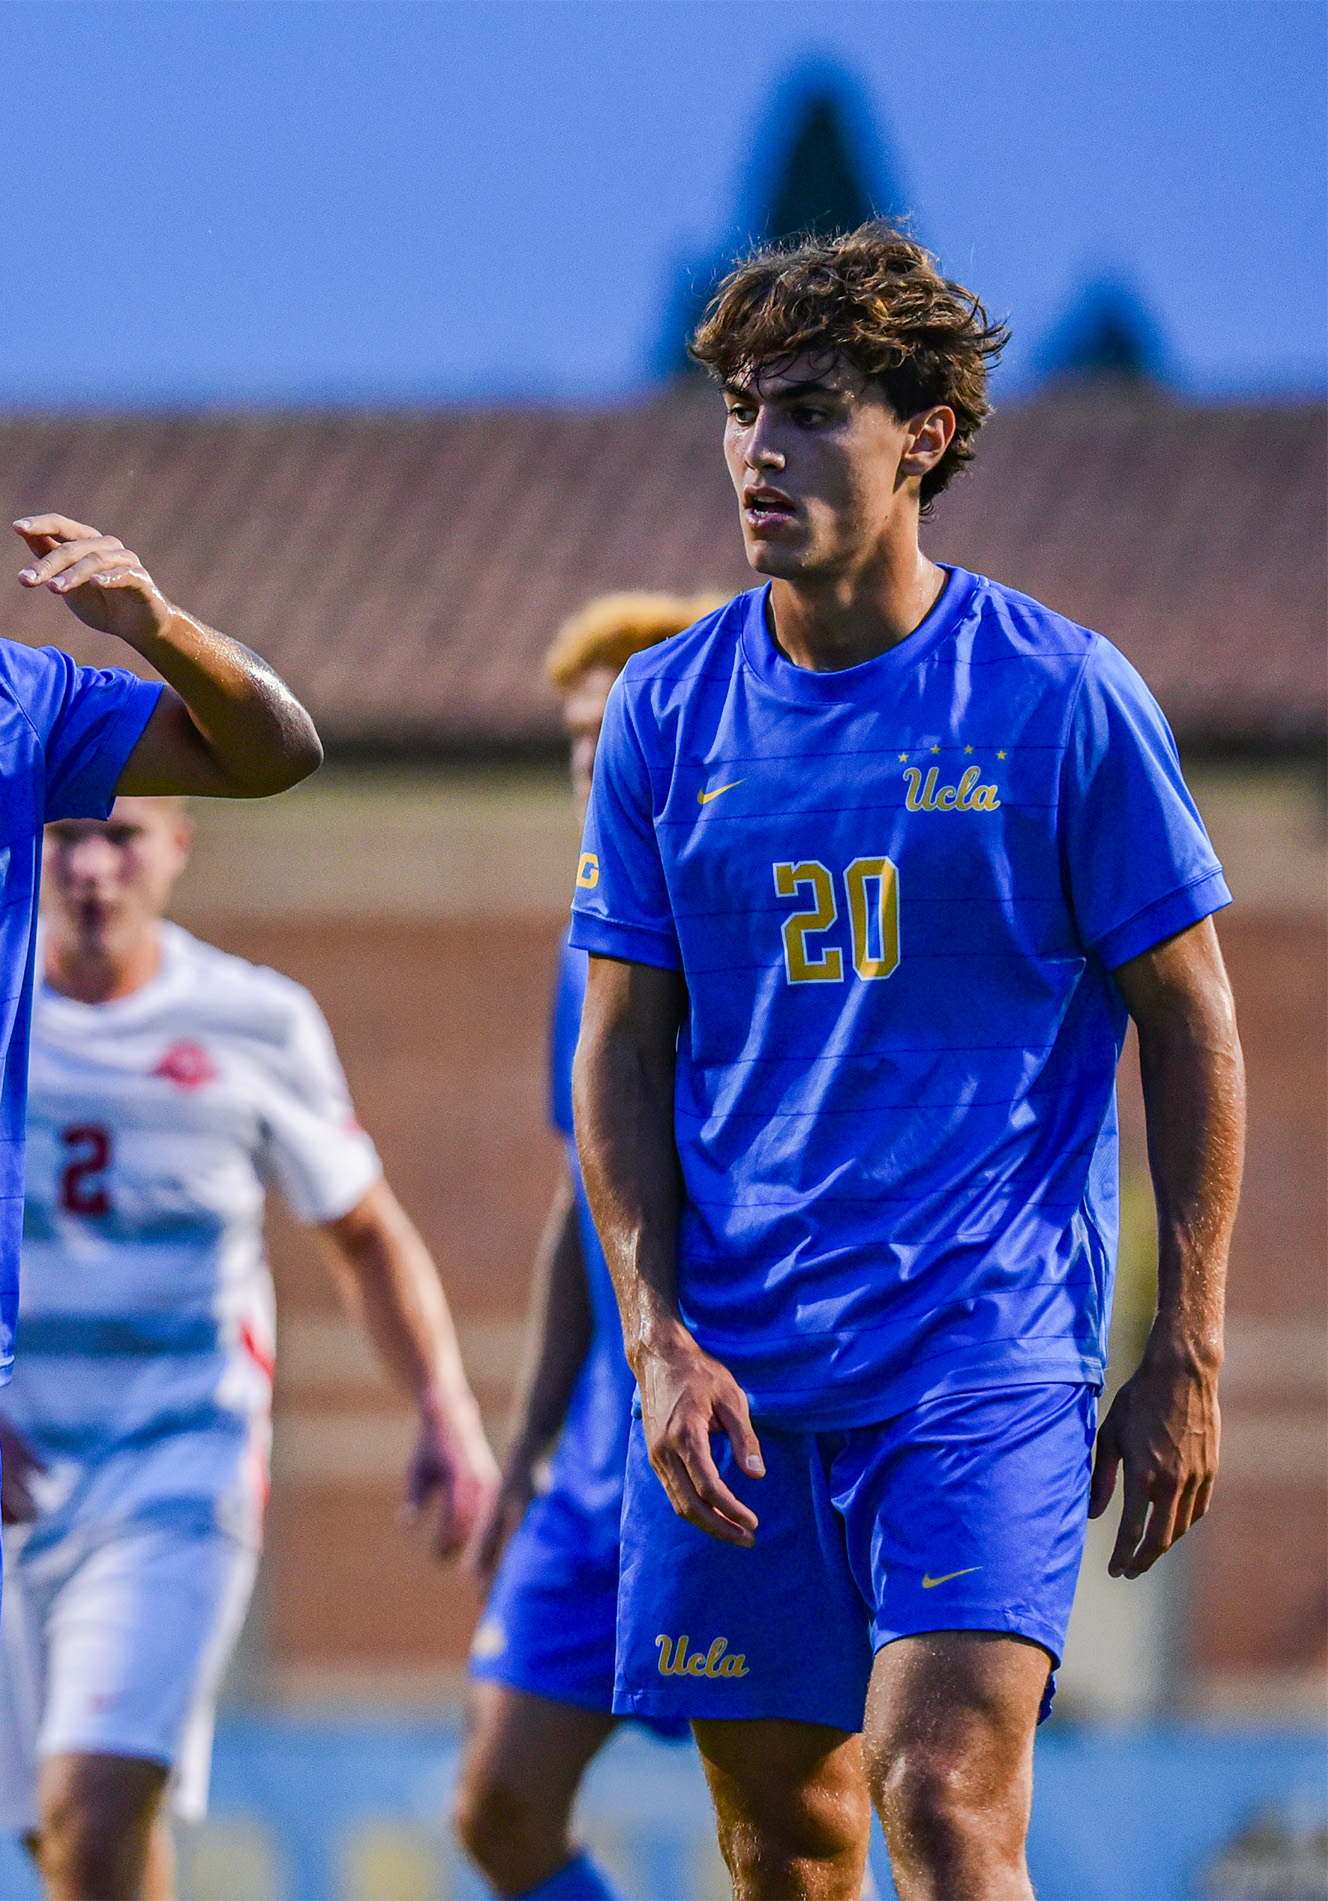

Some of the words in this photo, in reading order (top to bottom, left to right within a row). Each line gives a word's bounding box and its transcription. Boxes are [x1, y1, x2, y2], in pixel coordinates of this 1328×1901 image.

[903, 766, 1001, 811] Ucla
[773, 856, 901, 984] 20
[59, 1121, 110, 1218] 2
[655, 1634, 749, 1677] Ucla
